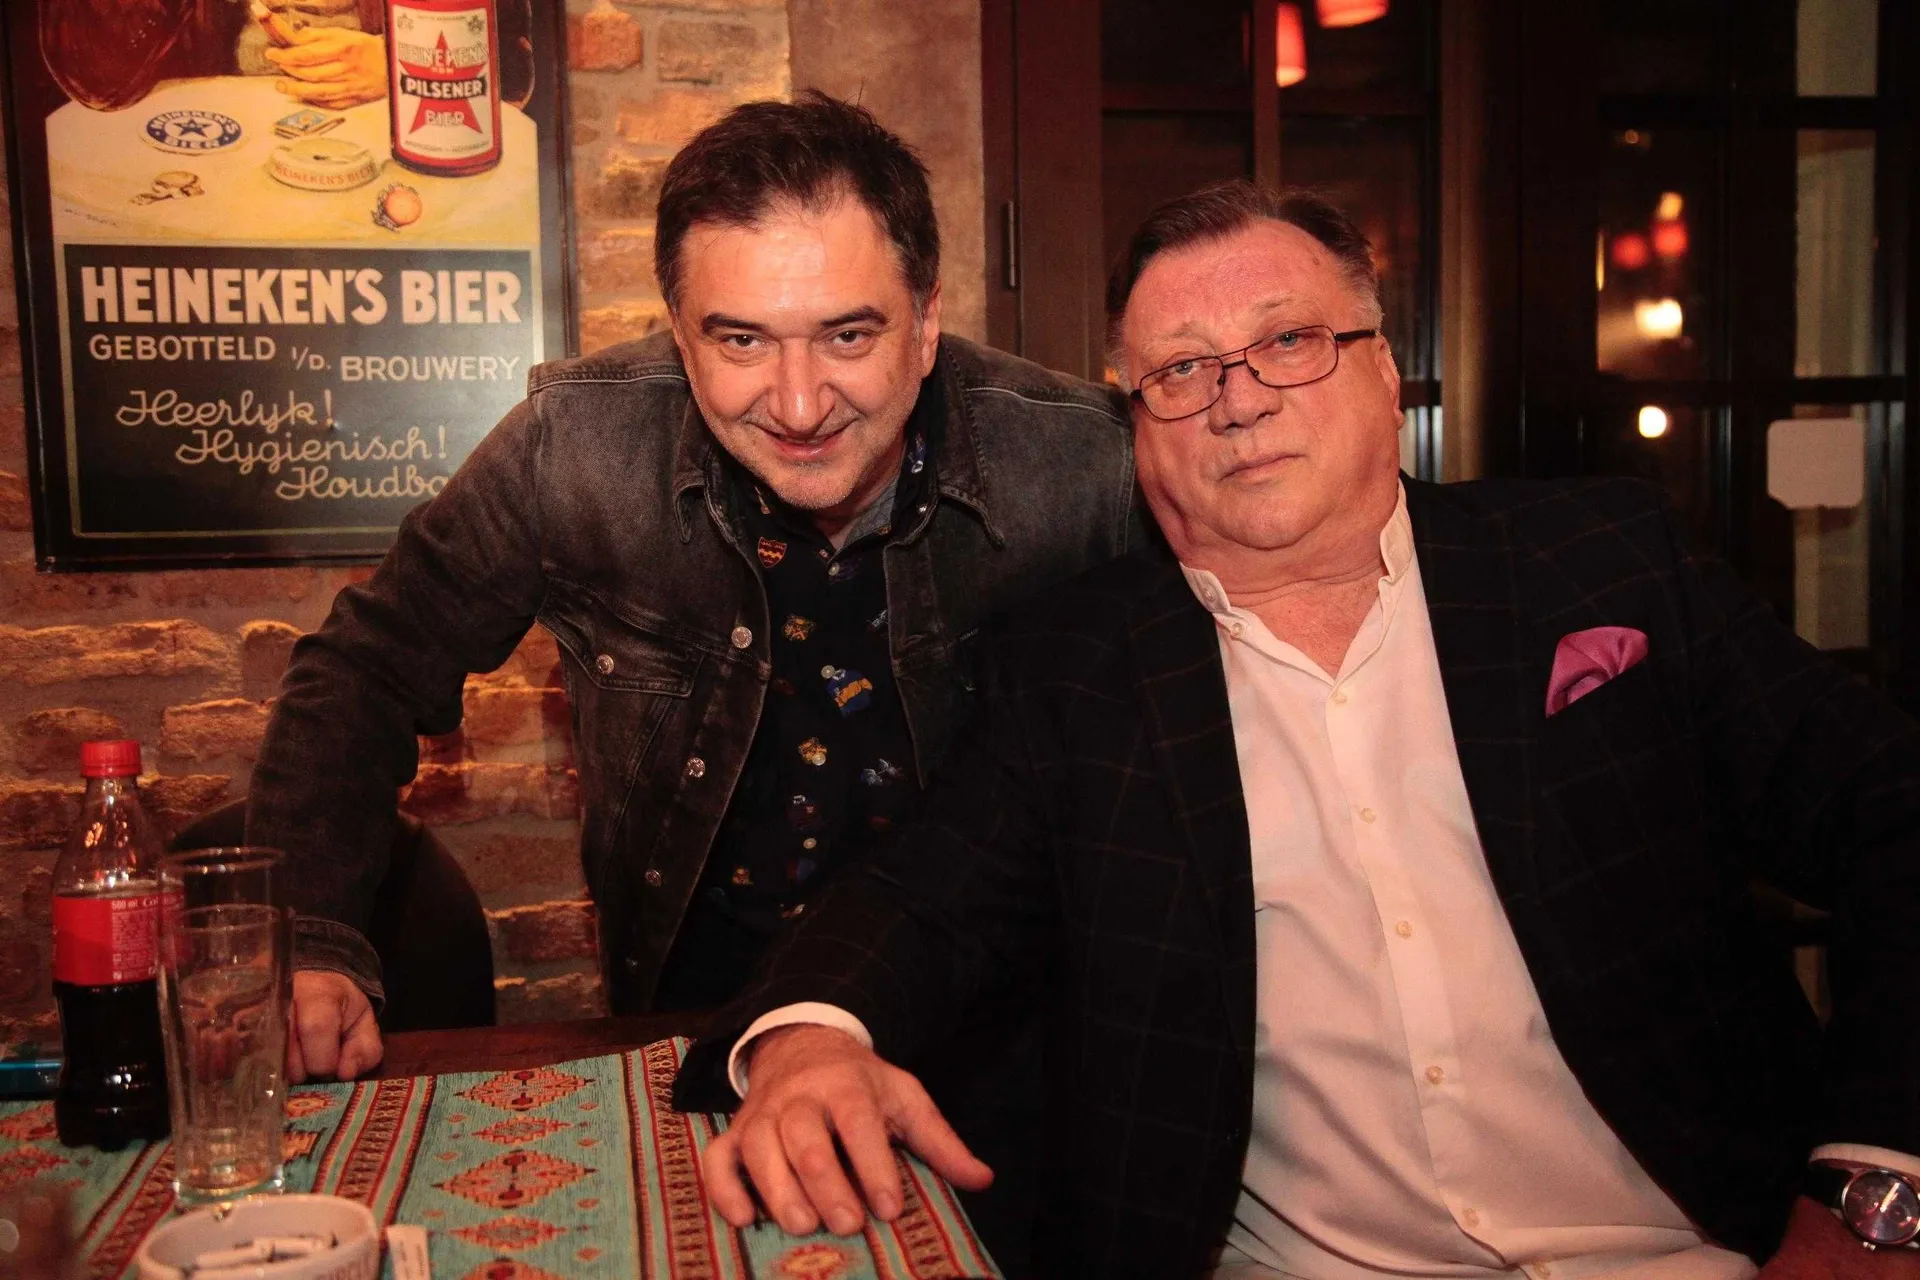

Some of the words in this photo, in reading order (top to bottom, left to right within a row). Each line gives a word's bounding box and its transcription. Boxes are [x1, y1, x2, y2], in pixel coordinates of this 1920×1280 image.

[405, 78, 483, 99] PILSENER
[425, 109, 465, 127] BIER
[81, 266, 388, 325] HEINEKEN'S
[401, 270, 523, 324] BIER
[89, 333, 277, 361] GEBOTTELD
[340, 355, 521, 382] BROUWERY
[115, 389, 334, 433] Heerlyk!
[175, 425, 447, 475] Hygienisch!
